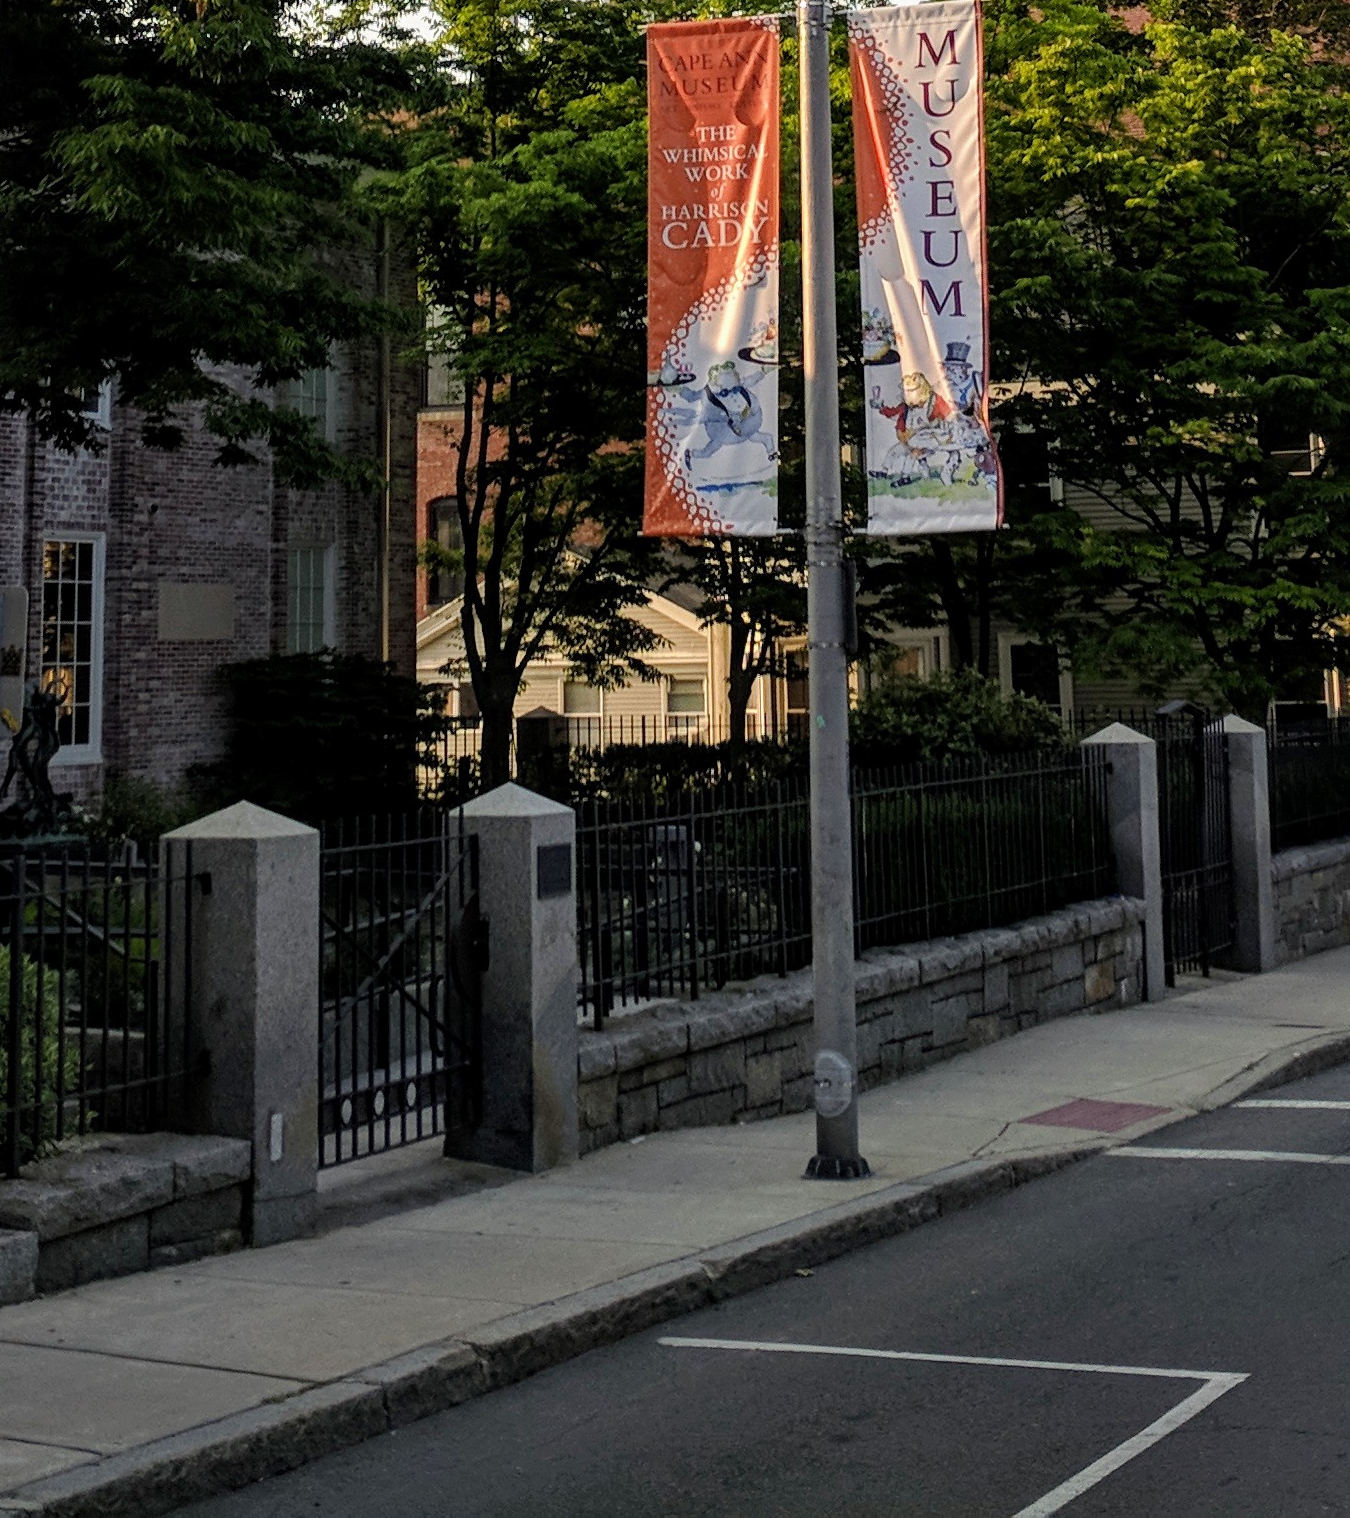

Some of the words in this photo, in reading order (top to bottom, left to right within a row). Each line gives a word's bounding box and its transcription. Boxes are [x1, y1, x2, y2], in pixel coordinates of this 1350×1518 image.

[658, 53, 713, 73] CAPE
[660, 73, 769, 96] MUSEUM
[696, 124, 737, 142] THE
[684, 163, 748, 182] WORK
[915, 29, 966, 317] MUSEUM
[711, 182, 726, 201] of
[661, 199, 768, 220] HARRISON
[661, 217, 768, 249] CADY
